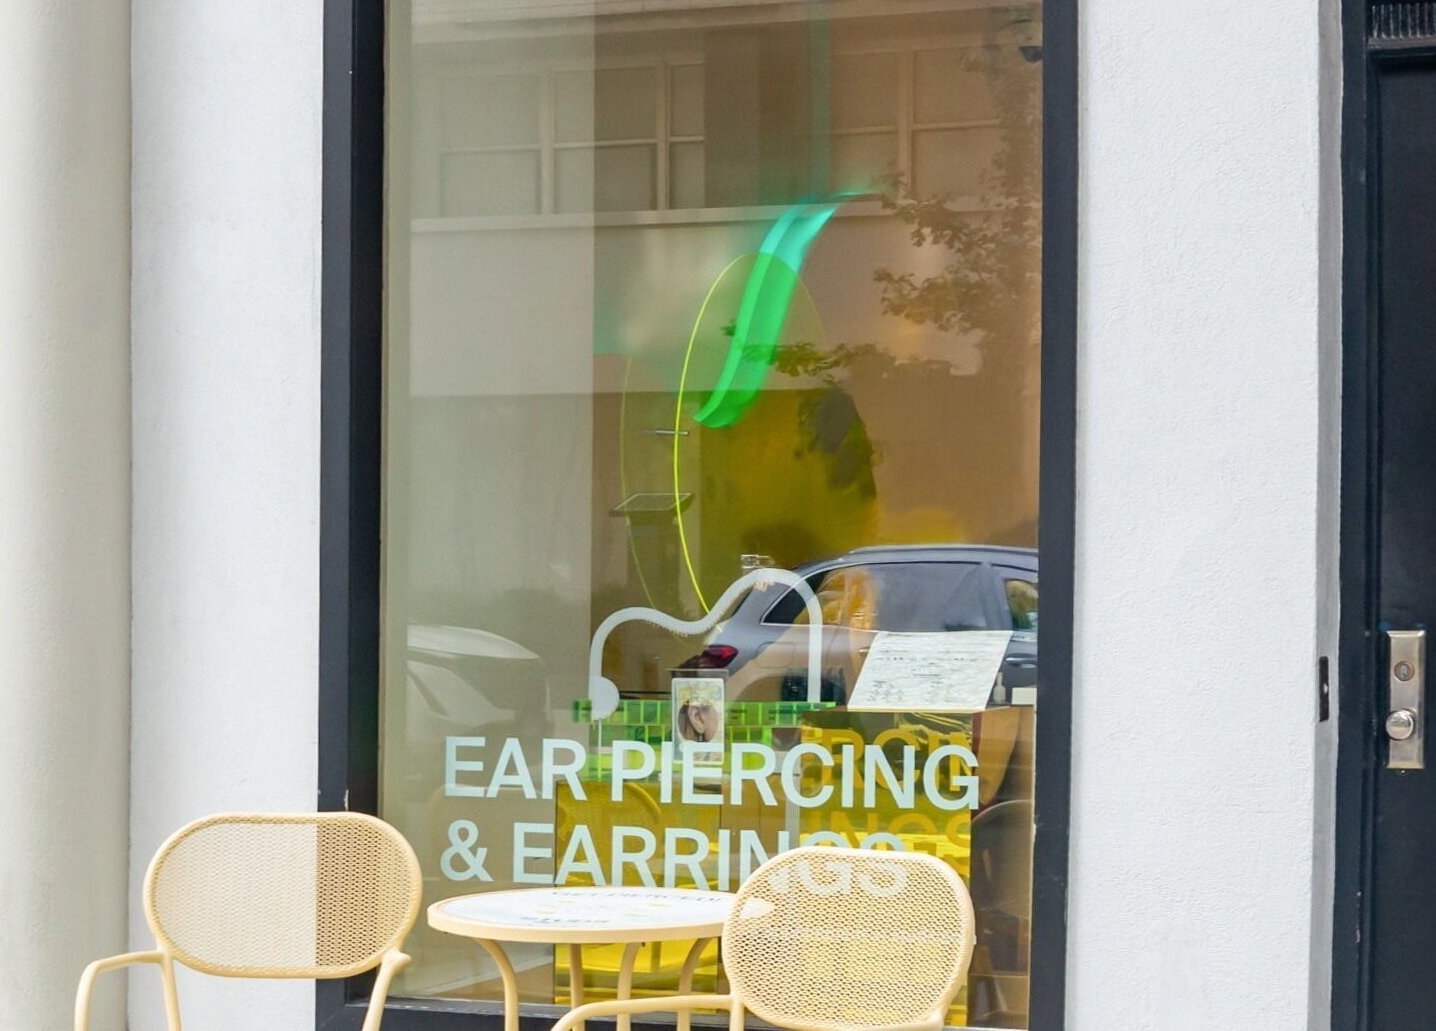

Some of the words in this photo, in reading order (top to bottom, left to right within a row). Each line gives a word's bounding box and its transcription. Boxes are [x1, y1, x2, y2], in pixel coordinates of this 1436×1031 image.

[445, 736, 587, 801] EAR
[611, 739, 979, 811] PIERCING
[440, 819, 494, 882] &
[513, 822, 906, 898] EARRINGS
